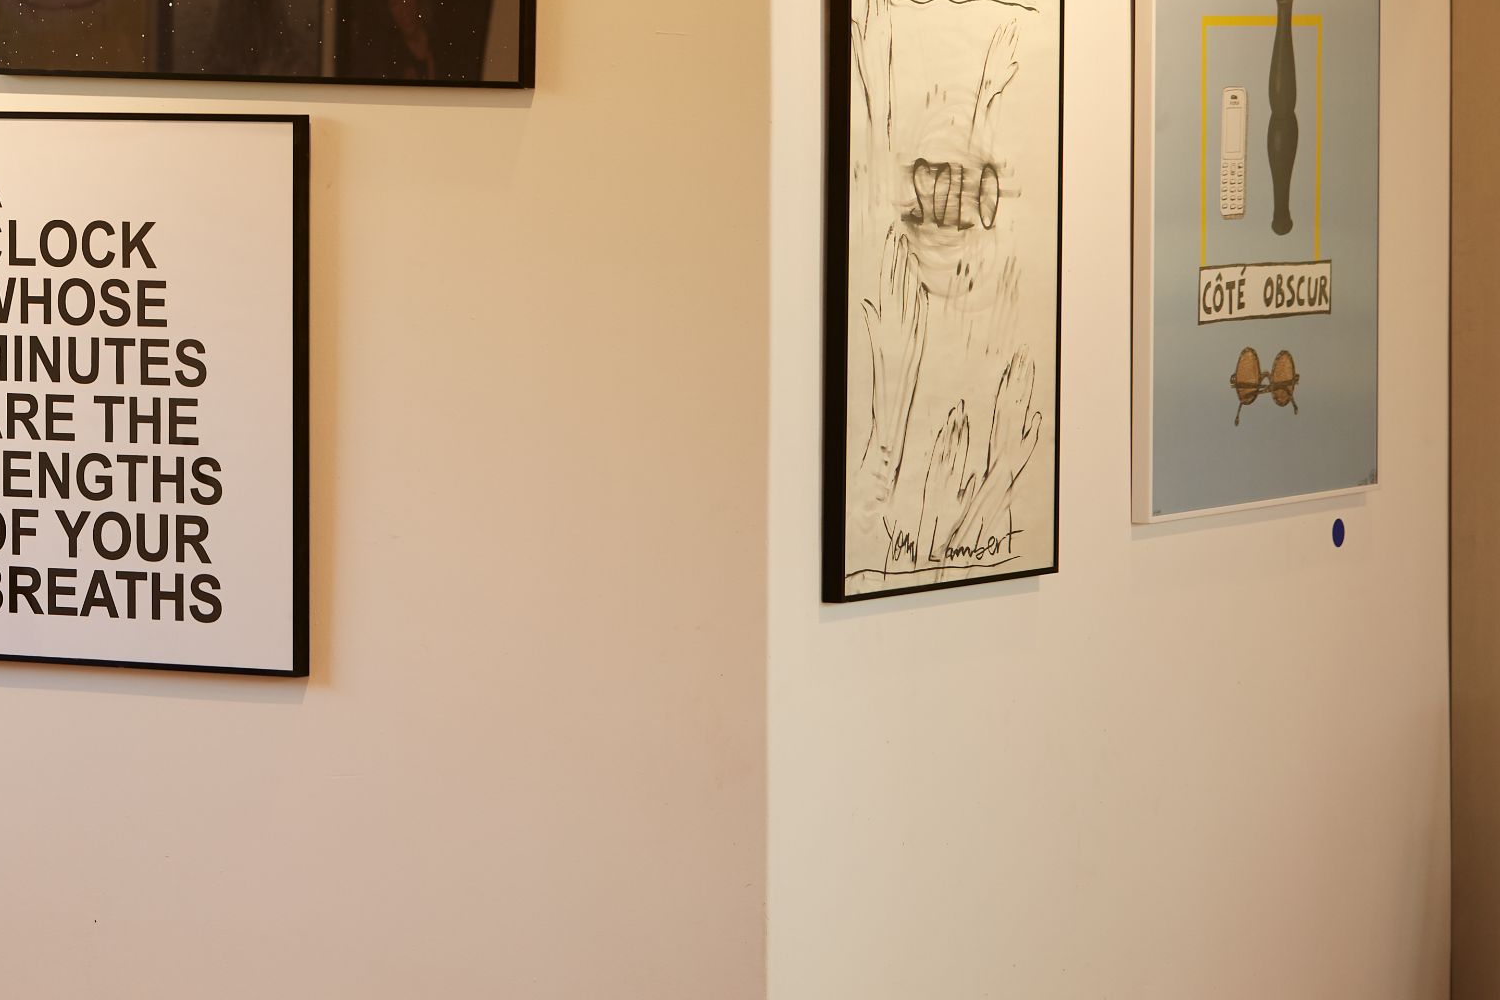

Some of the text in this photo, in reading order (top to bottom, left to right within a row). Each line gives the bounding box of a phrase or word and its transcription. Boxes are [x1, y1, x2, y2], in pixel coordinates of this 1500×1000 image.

[1202, 266, 1329, 315] CÔTÉ OBSCUR
[93, 395, 200, 446] THE
[54, 509, 212, 564] YOUR
